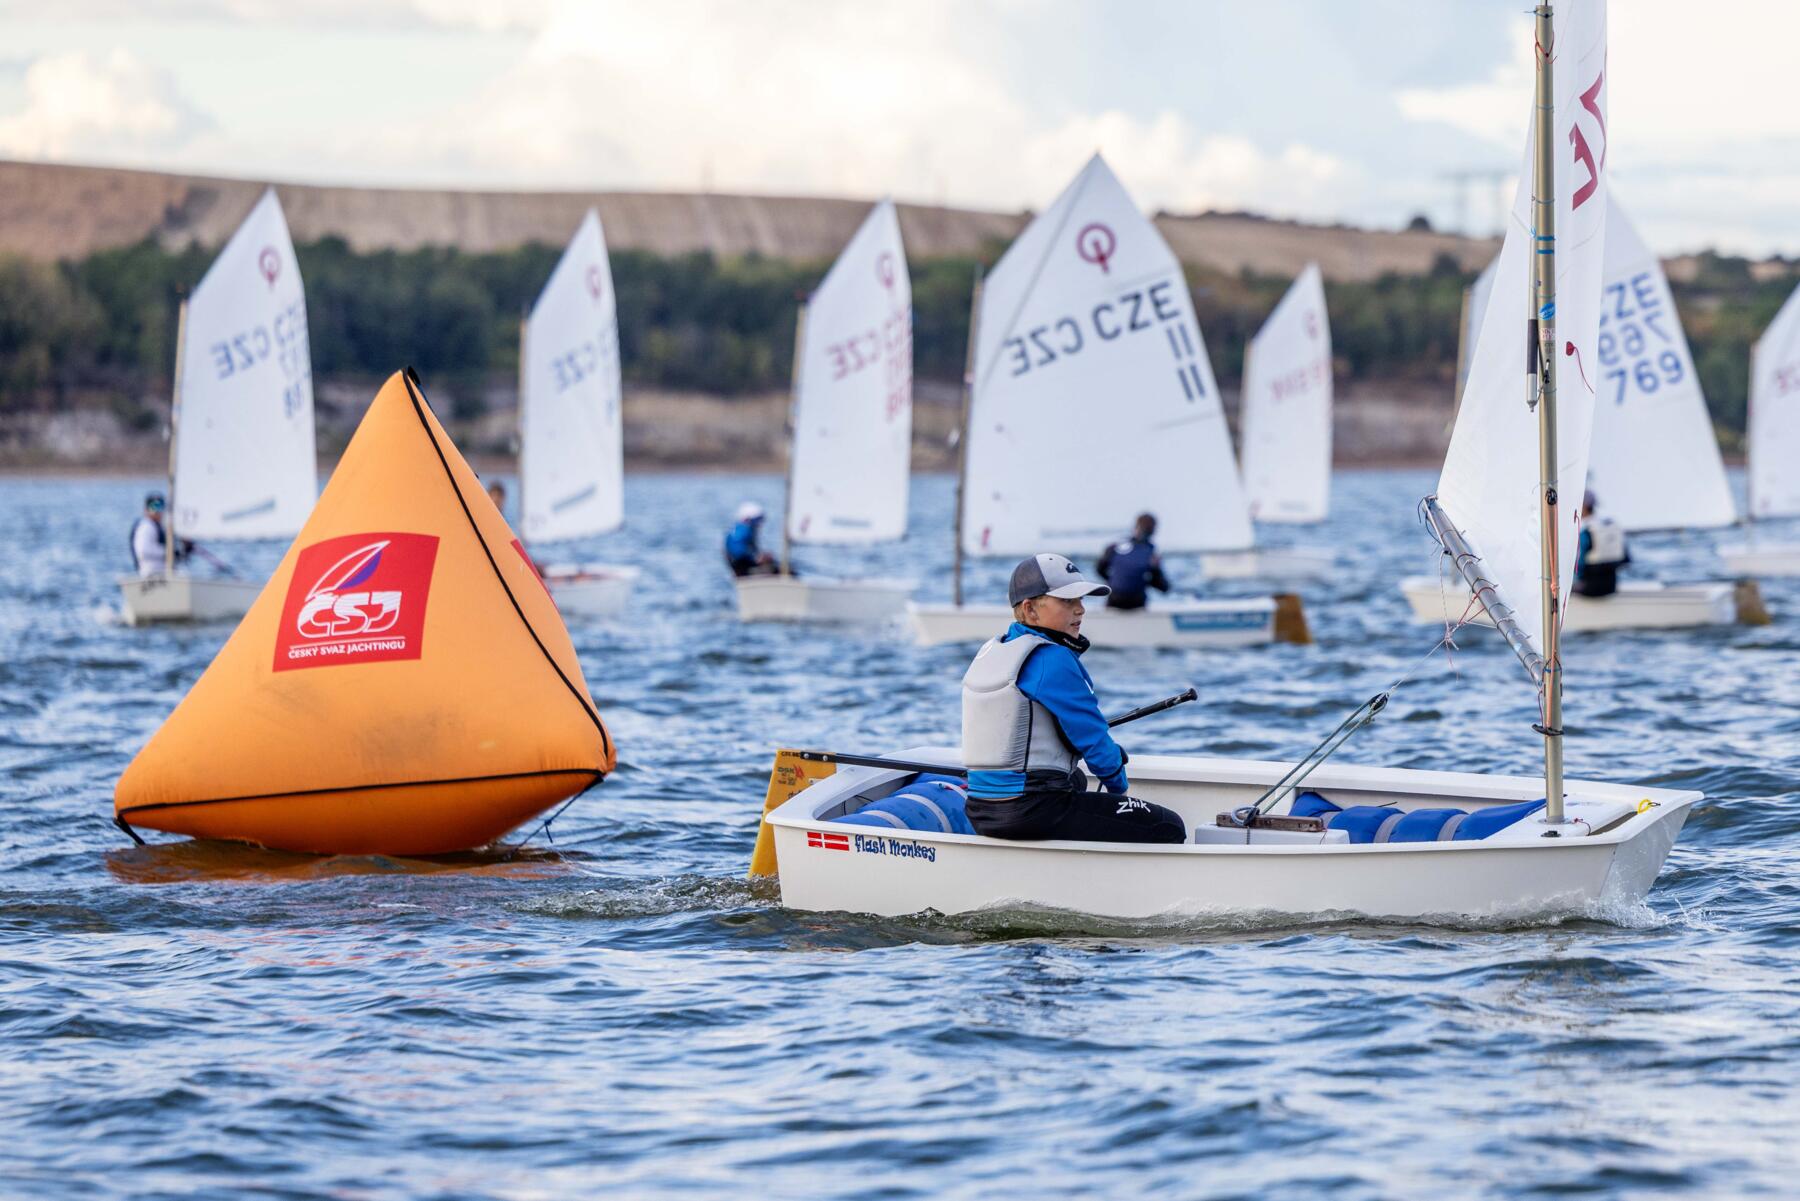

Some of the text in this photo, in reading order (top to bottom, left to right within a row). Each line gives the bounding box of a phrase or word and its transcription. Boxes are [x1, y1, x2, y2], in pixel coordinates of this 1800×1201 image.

[1091, 280, 1182, 342] CZE
[1599, 272, 1661, 327] ZE
[1176, 363, 1207, 403] 11
[1604, 349, 1685, 405] 769
[320, 645, 346, 656] SVAZ
[346, 641, 405, 655] JACHTINGU
